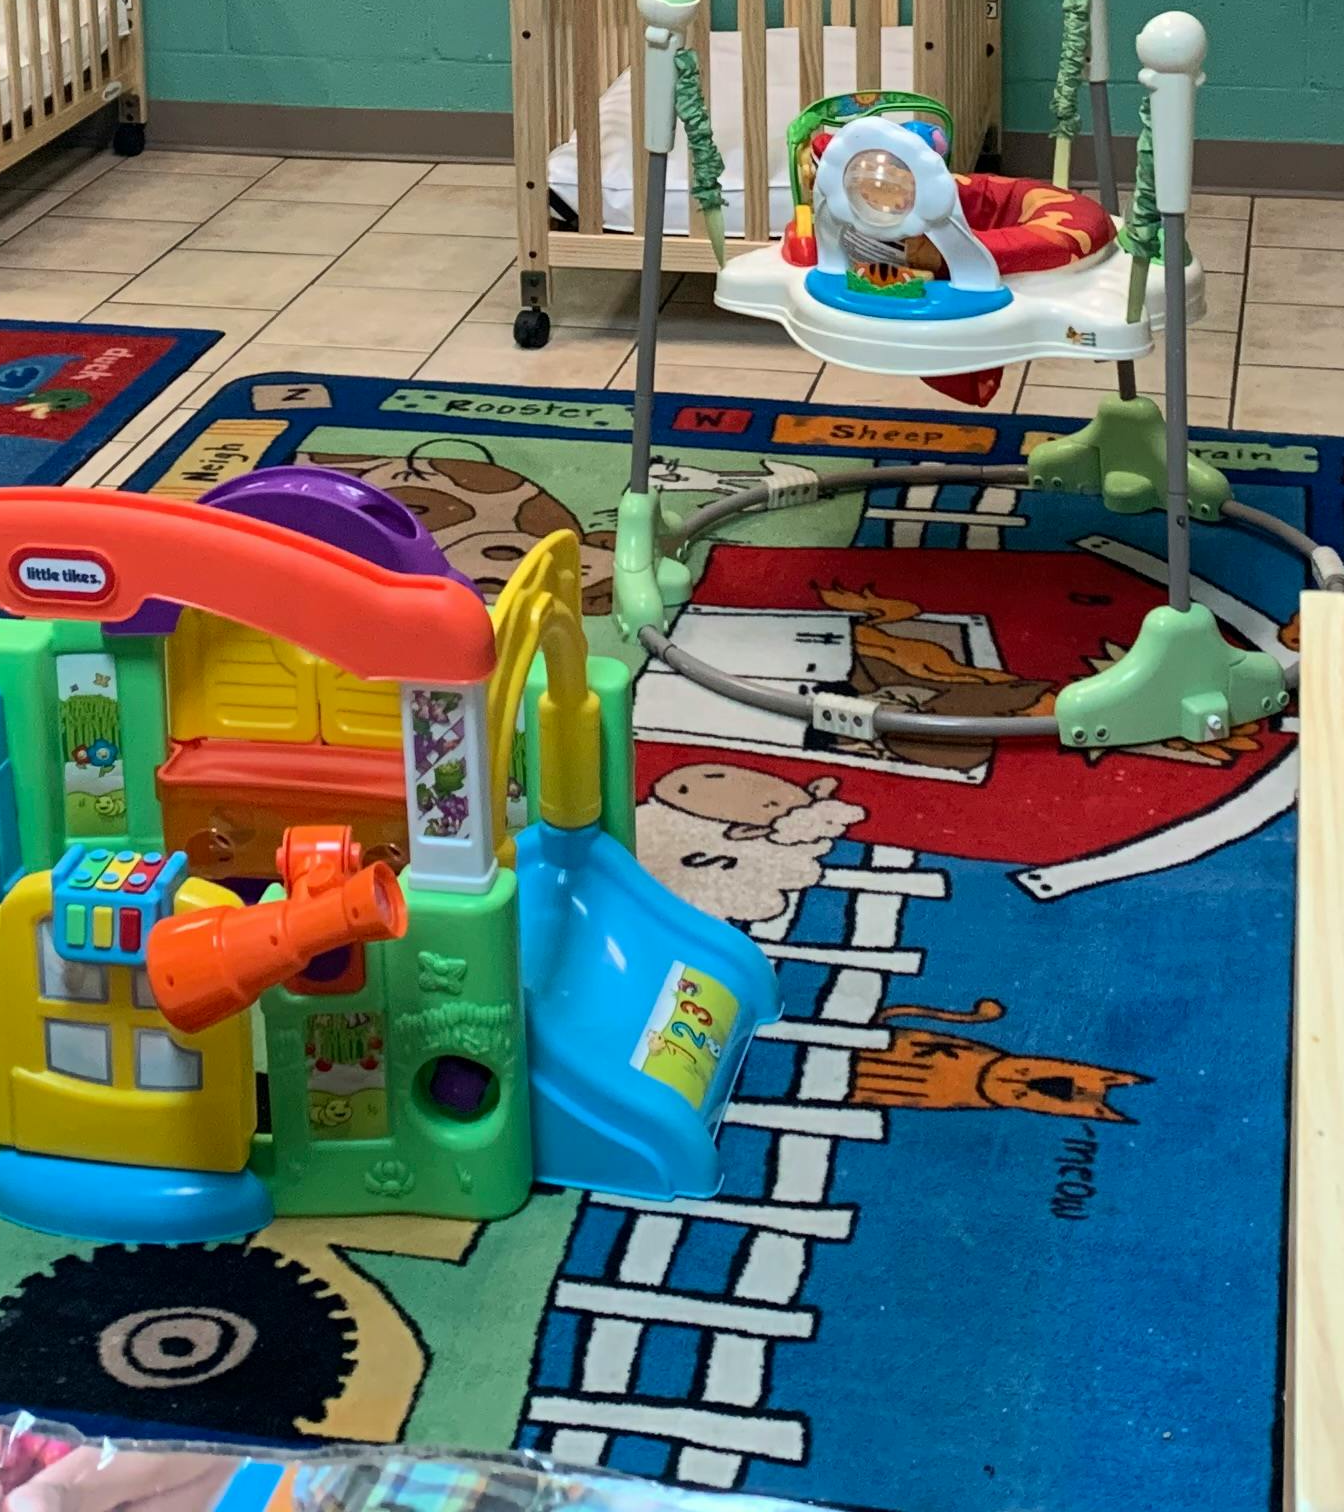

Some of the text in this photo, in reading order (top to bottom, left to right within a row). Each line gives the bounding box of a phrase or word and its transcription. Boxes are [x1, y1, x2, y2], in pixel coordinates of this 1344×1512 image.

[69, 347, 135, 381] duck
[443, 397, 605, 419] Rooster
[828, 423, 944, 443] Sheep
[180, 442, 250, 483] Neigh
[26, 566, 60, 582] little
[680, 1000, 713, 1027] 3
[671, 1021, 706, 1049] 2
